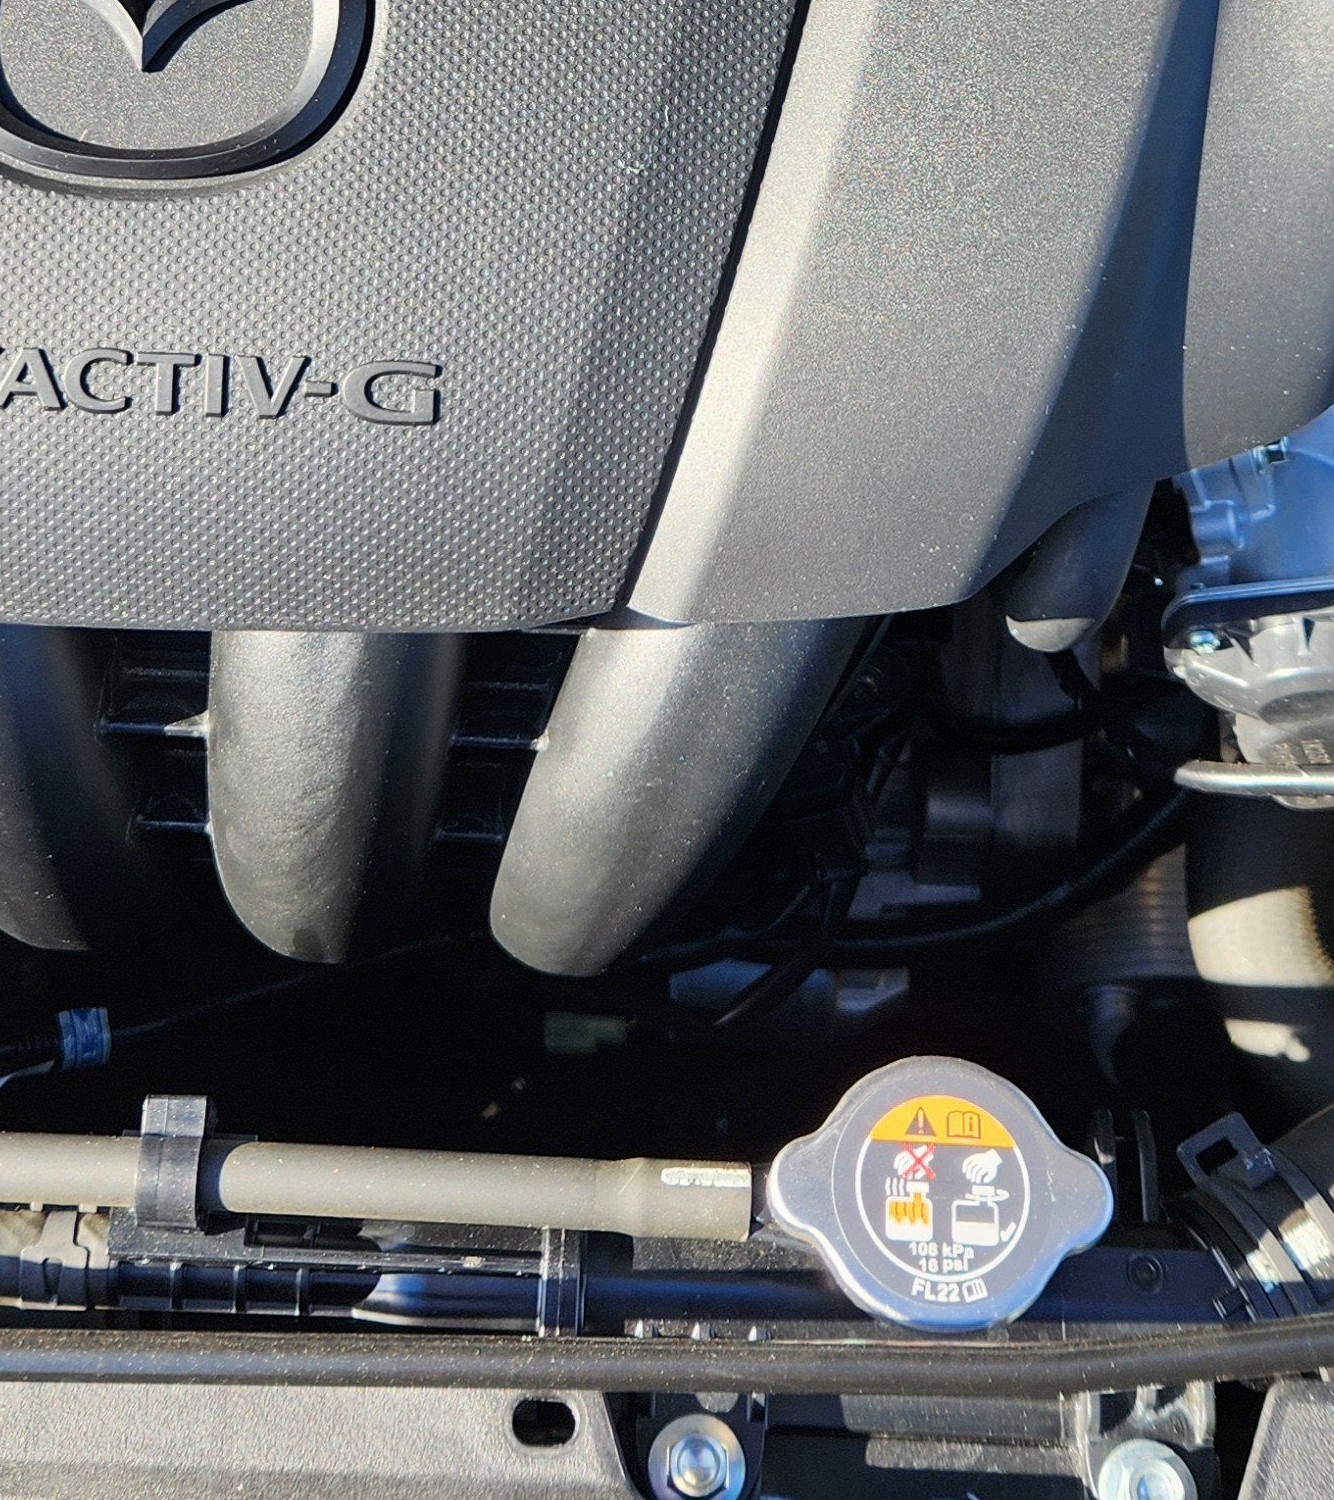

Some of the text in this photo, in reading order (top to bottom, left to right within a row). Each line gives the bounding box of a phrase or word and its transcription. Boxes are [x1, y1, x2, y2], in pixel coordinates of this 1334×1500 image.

[909, 1241, 975, 1260] 108 kPa
[919, 1257, 969, 1274] 16 psi
[911, 1277, 961, 1303] FL22
